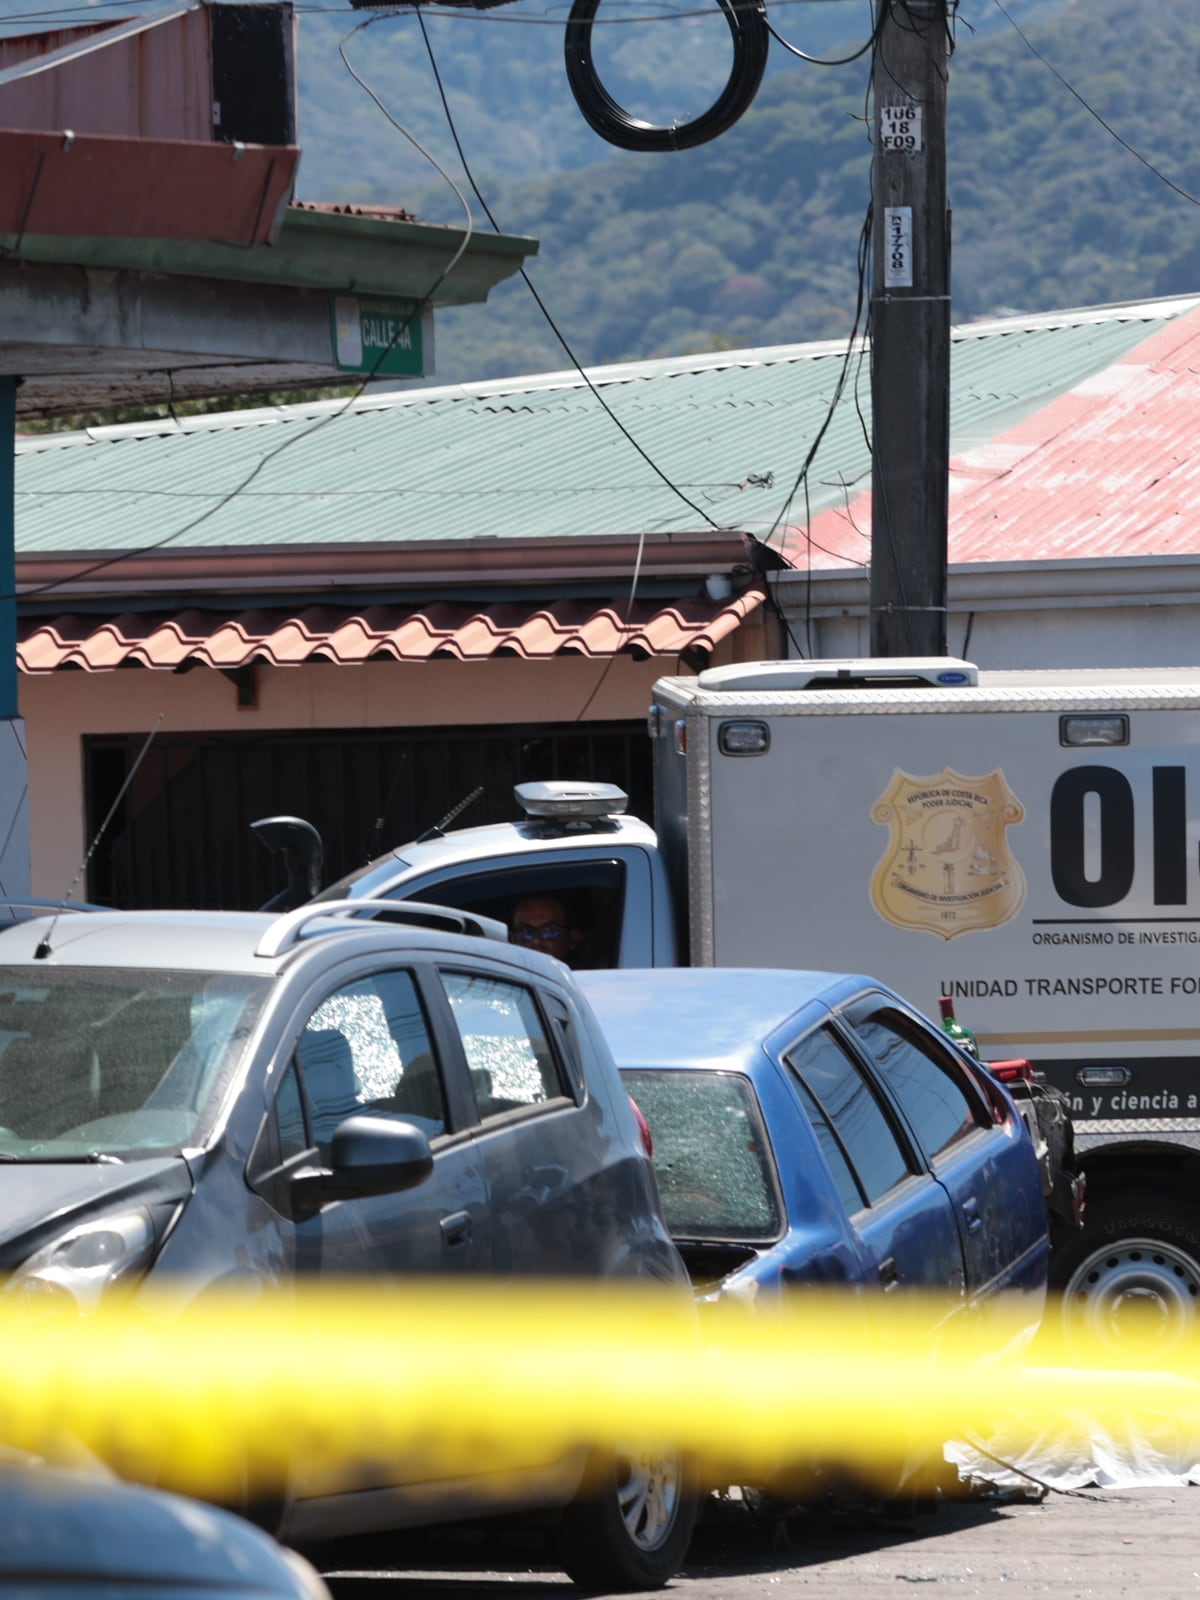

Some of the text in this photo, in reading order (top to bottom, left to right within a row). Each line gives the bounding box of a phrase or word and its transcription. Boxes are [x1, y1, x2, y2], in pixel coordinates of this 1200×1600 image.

[884, 107, 916, 121] 106
[884, 135, 916, 149] F09
[362, 317, 396, 349] CALLE
[1032, 932, 1114, 945] ORGANISMO
[1118, 932, 1135, 944] DE
[940, 979, 1018, 997] UNIDAD
[1025, 977, 1164, 996] TRANSPORTE
[1090, 1096, 1103, 1117] y
[1110, 1090, 1179, 1110] ciencia
[1187, 1094, 1198, 1109] a
